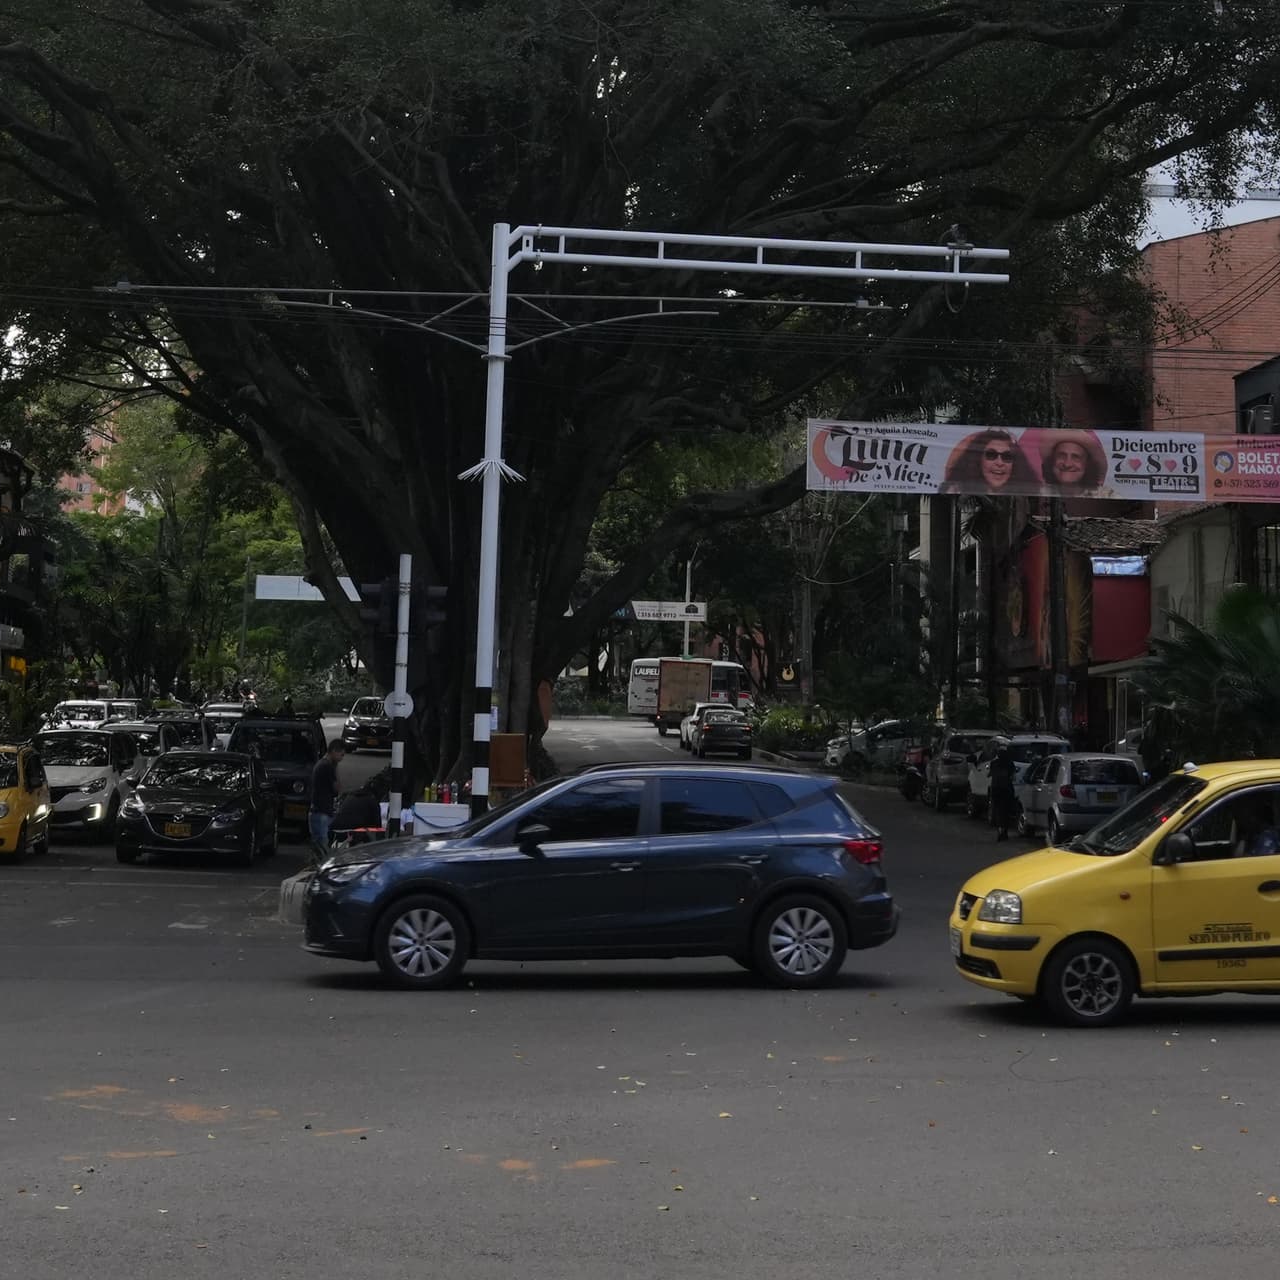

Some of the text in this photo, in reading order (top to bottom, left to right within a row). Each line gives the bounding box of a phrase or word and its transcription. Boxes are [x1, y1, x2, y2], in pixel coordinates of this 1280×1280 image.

[902, 427, 938, 438] Descalza
[830, 425, 929, 472] Luna
[1111, 437, 1197, 454] Diciembre
[1111, 454, 1198, 474] 7 8 9
[849, 472, 869, 483] De
